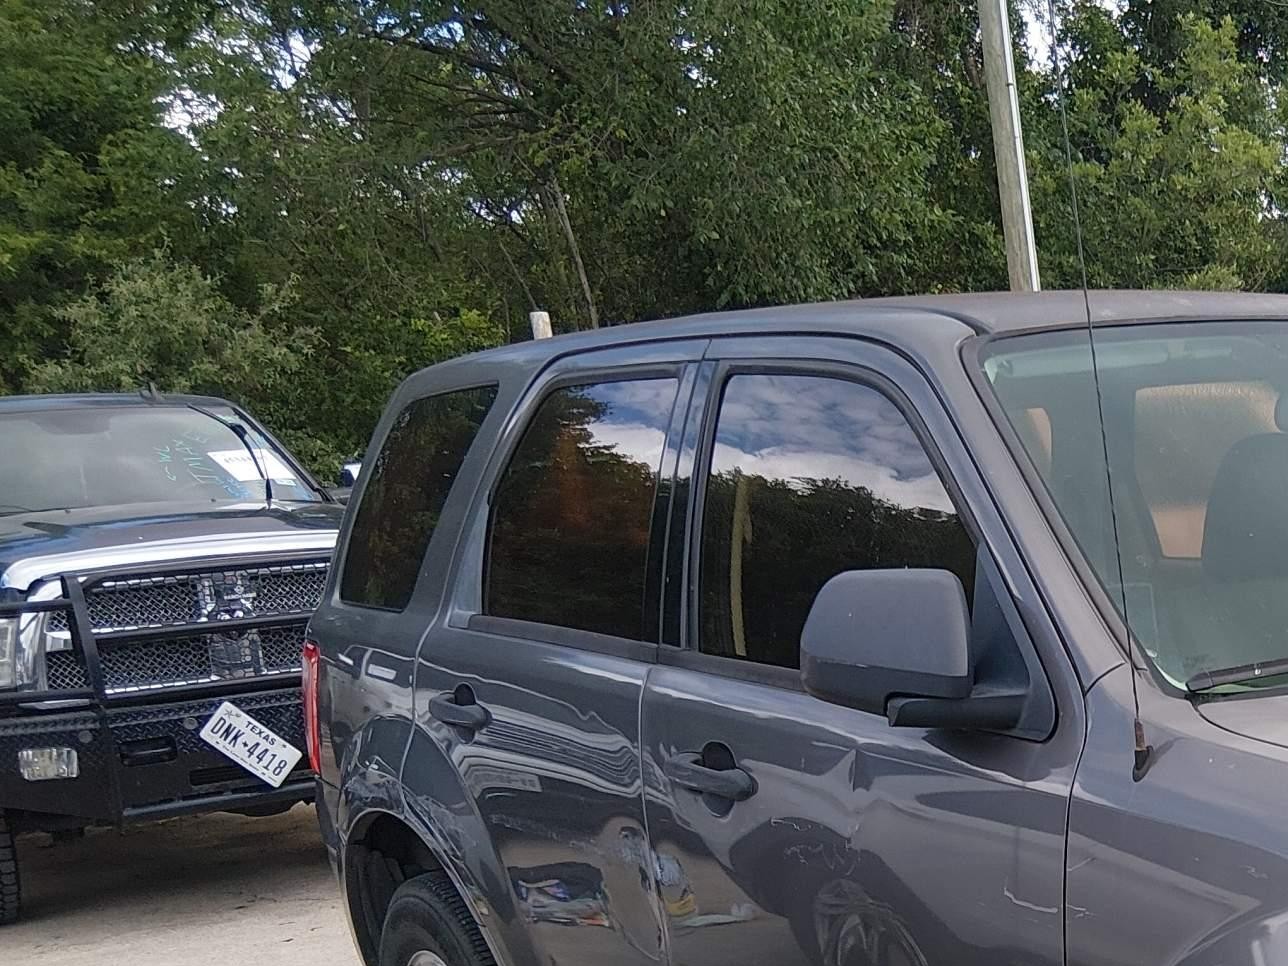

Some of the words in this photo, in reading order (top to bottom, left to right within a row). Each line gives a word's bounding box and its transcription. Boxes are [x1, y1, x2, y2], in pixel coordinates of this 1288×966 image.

[210, 716, 245, 748] DNK
[246, 741, 288, 777] 4418
[245, 720, 277, 746] TEXAS
